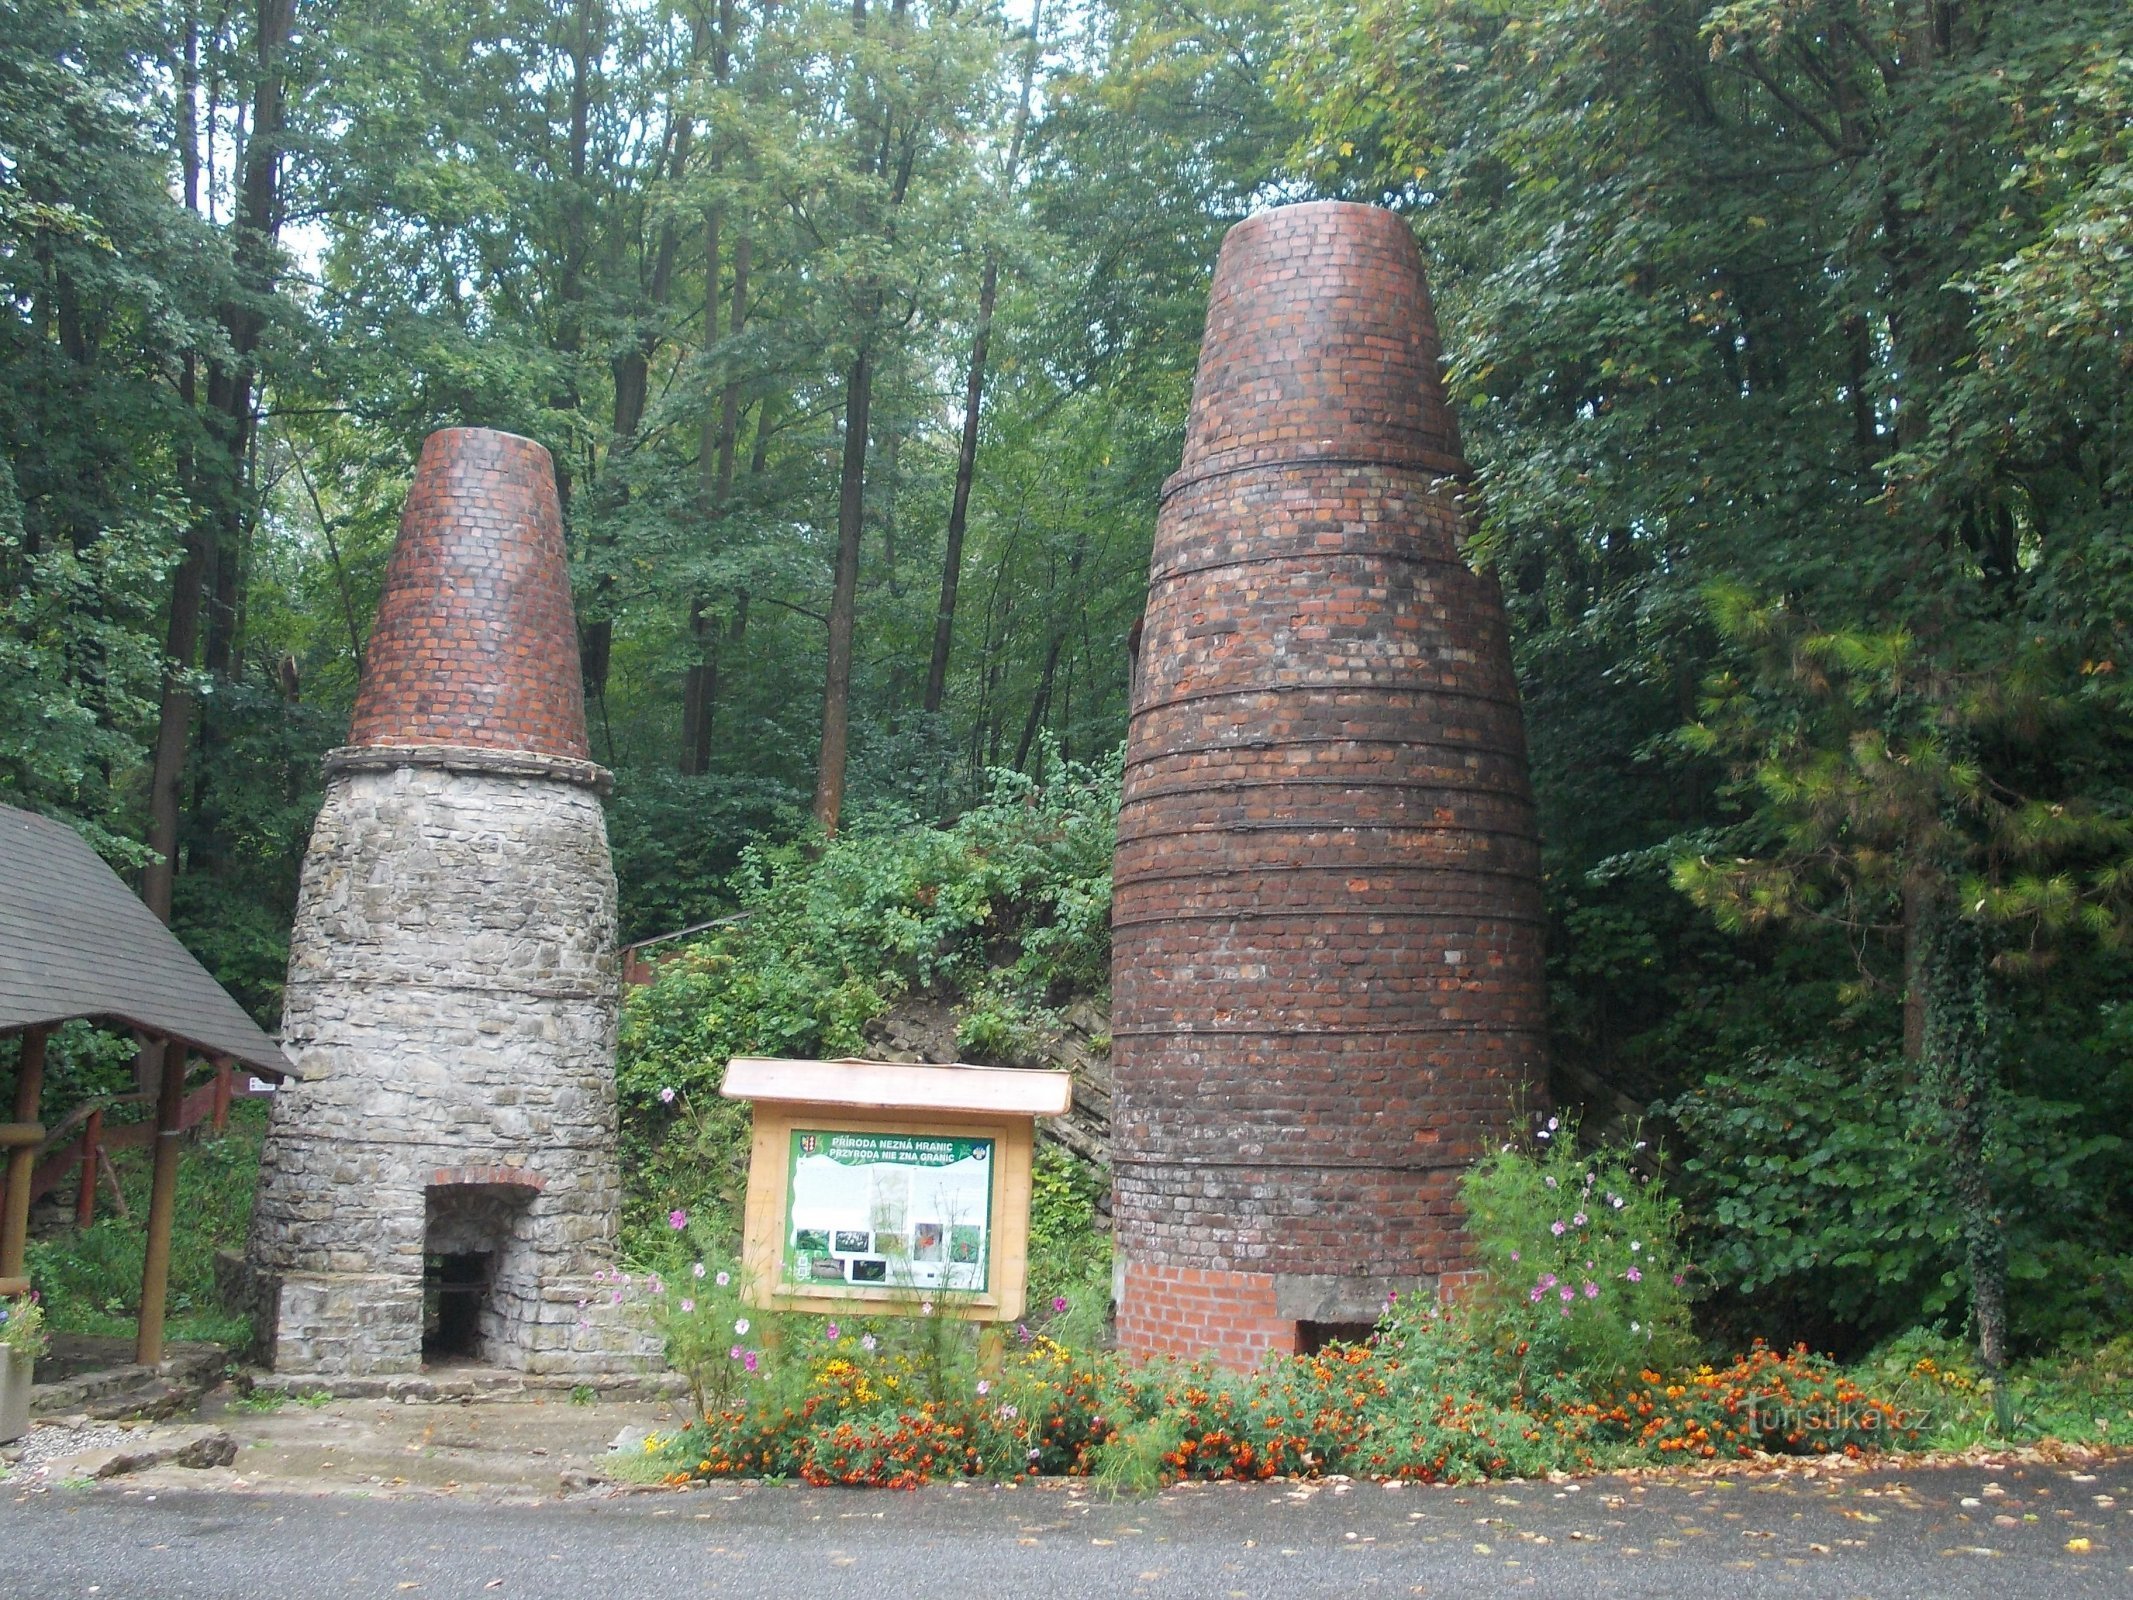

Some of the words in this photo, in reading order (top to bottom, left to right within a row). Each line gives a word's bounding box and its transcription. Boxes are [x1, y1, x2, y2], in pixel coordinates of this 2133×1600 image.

[832, 1135, 876, 1148] PŘÍRODA
[880, 1138, 912, 1149] NEZNÁ
[916, 1141, 953, 1151] HRANIC
[830, 1148, 879, 1158] PRZYRODA
[882, 1151, 896, 1159] NIE
[899, 1152, 918, 1161] ZNA
[920, 1153, 955, 1162] GRANIC
